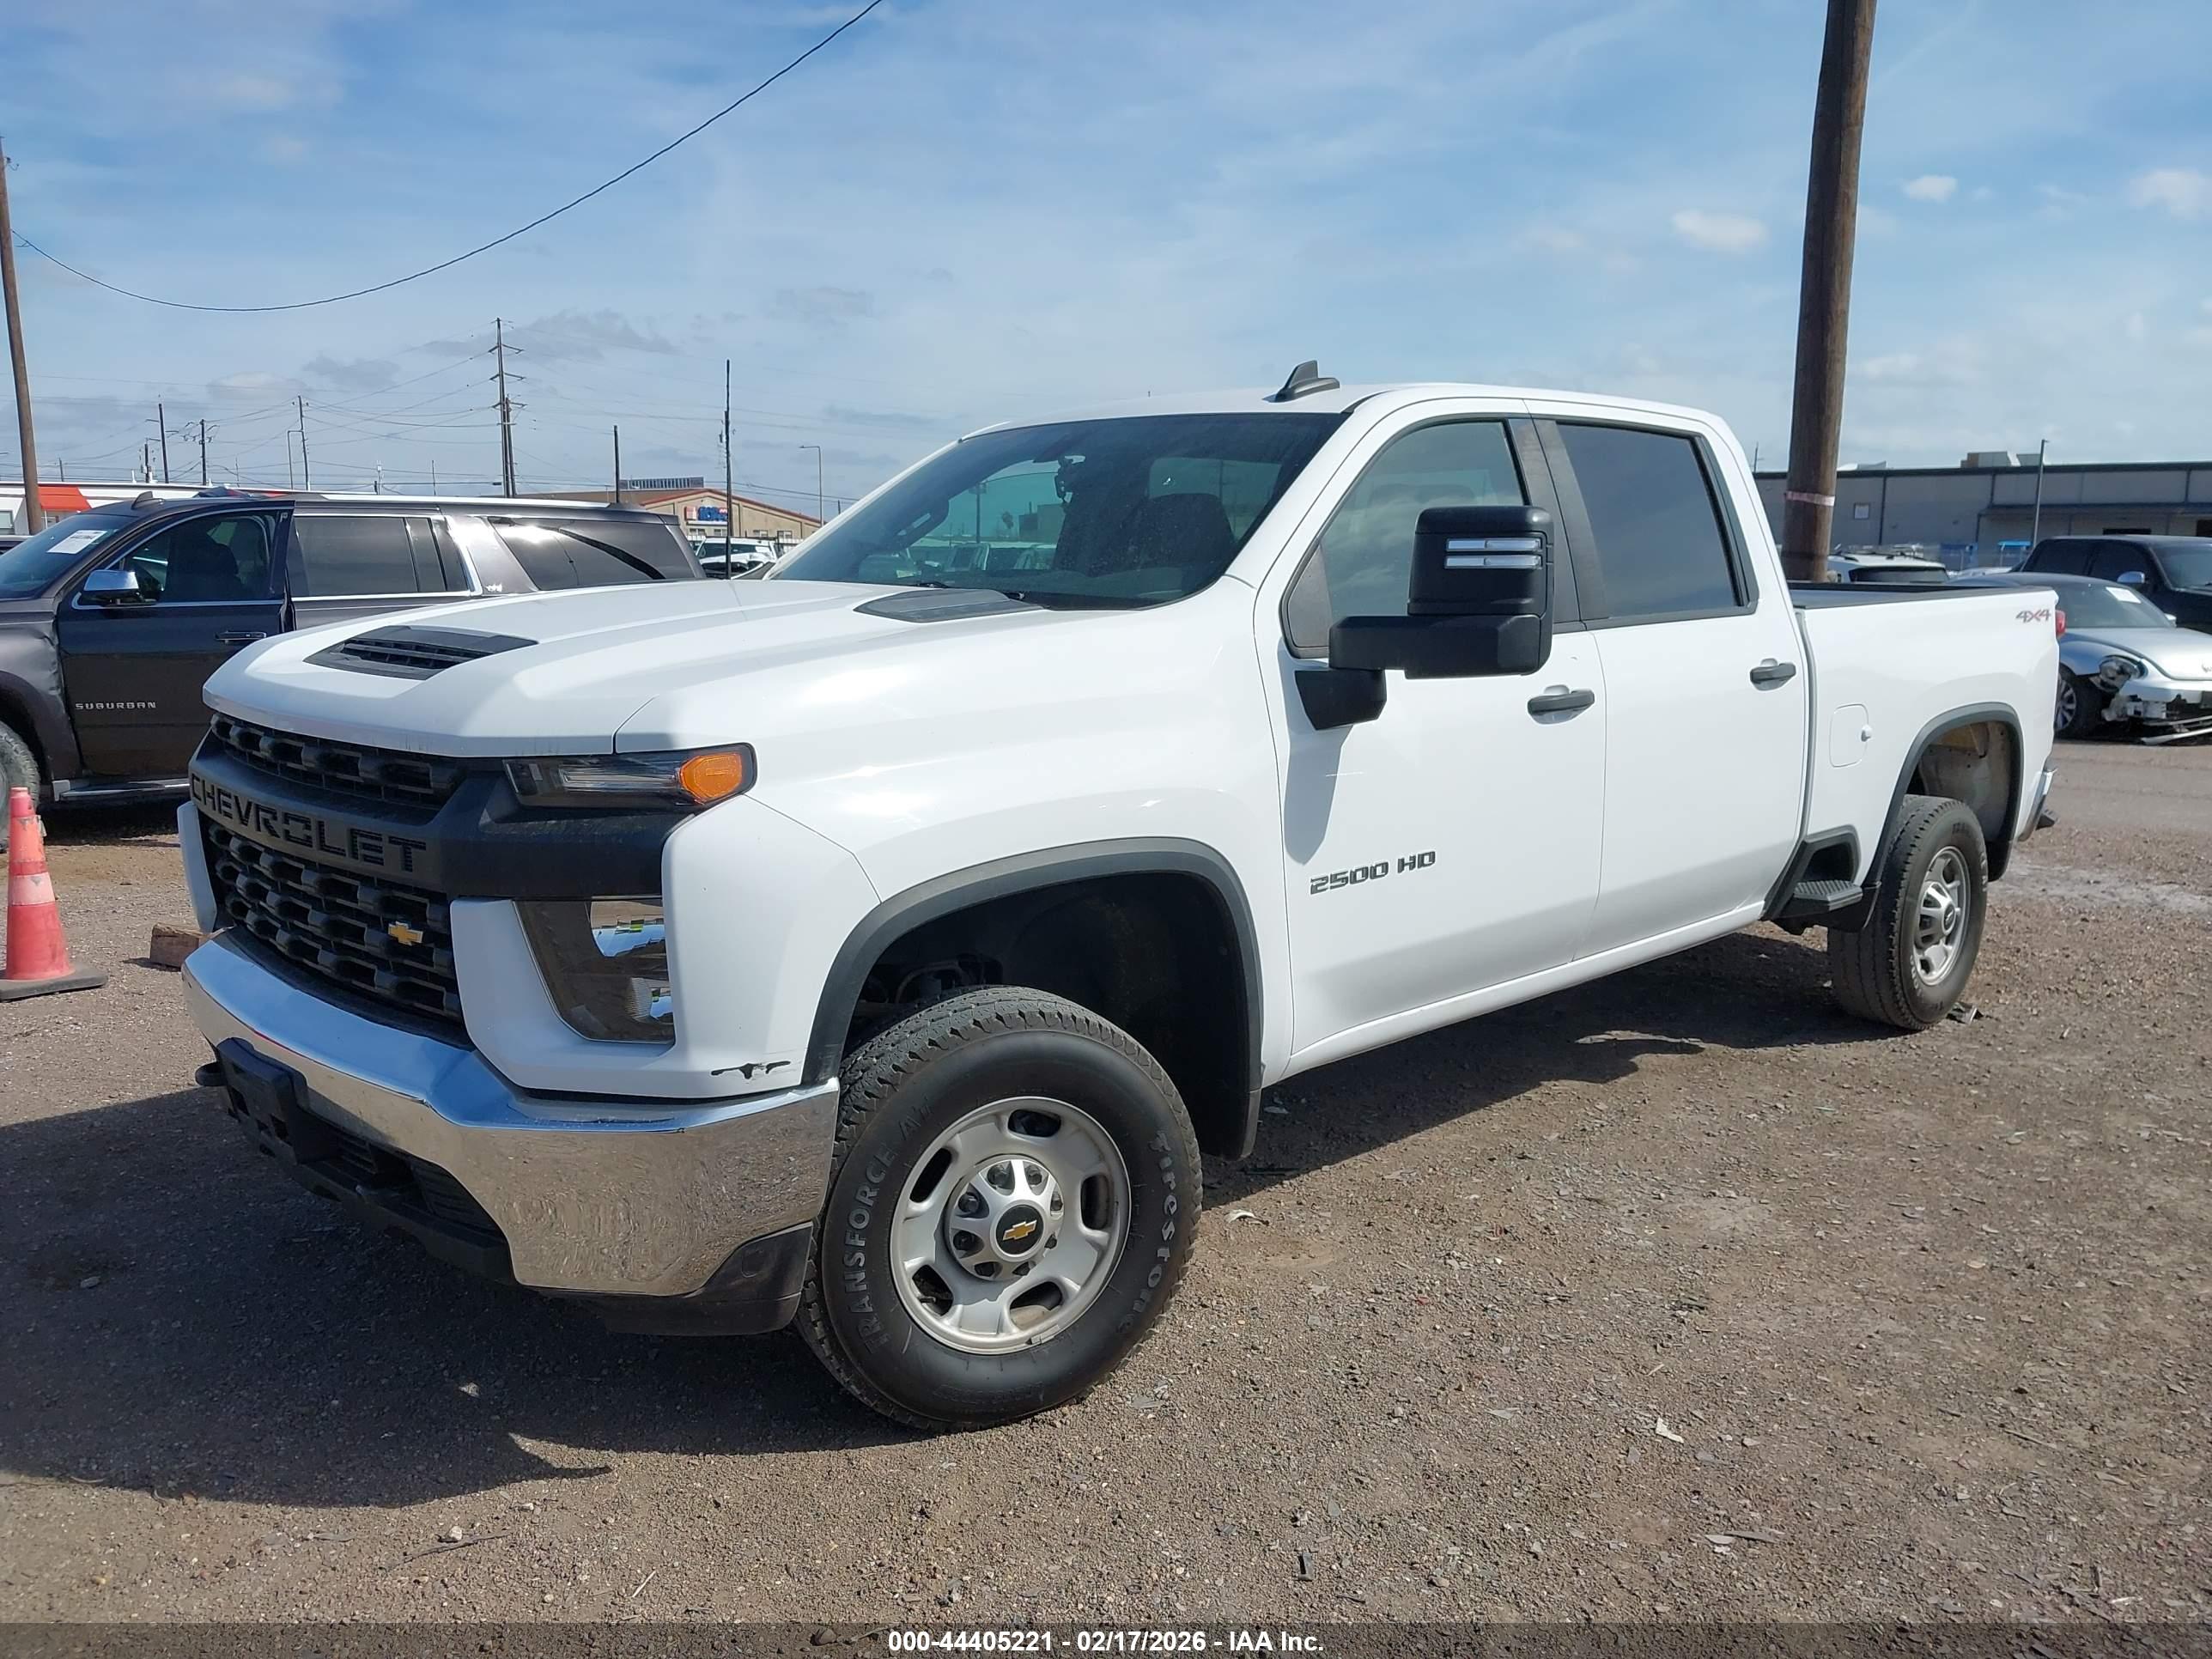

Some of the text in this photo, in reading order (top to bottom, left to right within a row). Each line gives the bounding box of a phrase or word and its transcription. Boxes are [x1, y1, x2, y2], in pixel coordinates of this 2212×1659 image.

[75, 702, 157, 710] SUBURBAN
[191, 772, 427, 873] CHEVROLET
[1310, 850, 1437, 895] 2500 HD
[842, 1143, 897, 1355] TRANSFORCE
